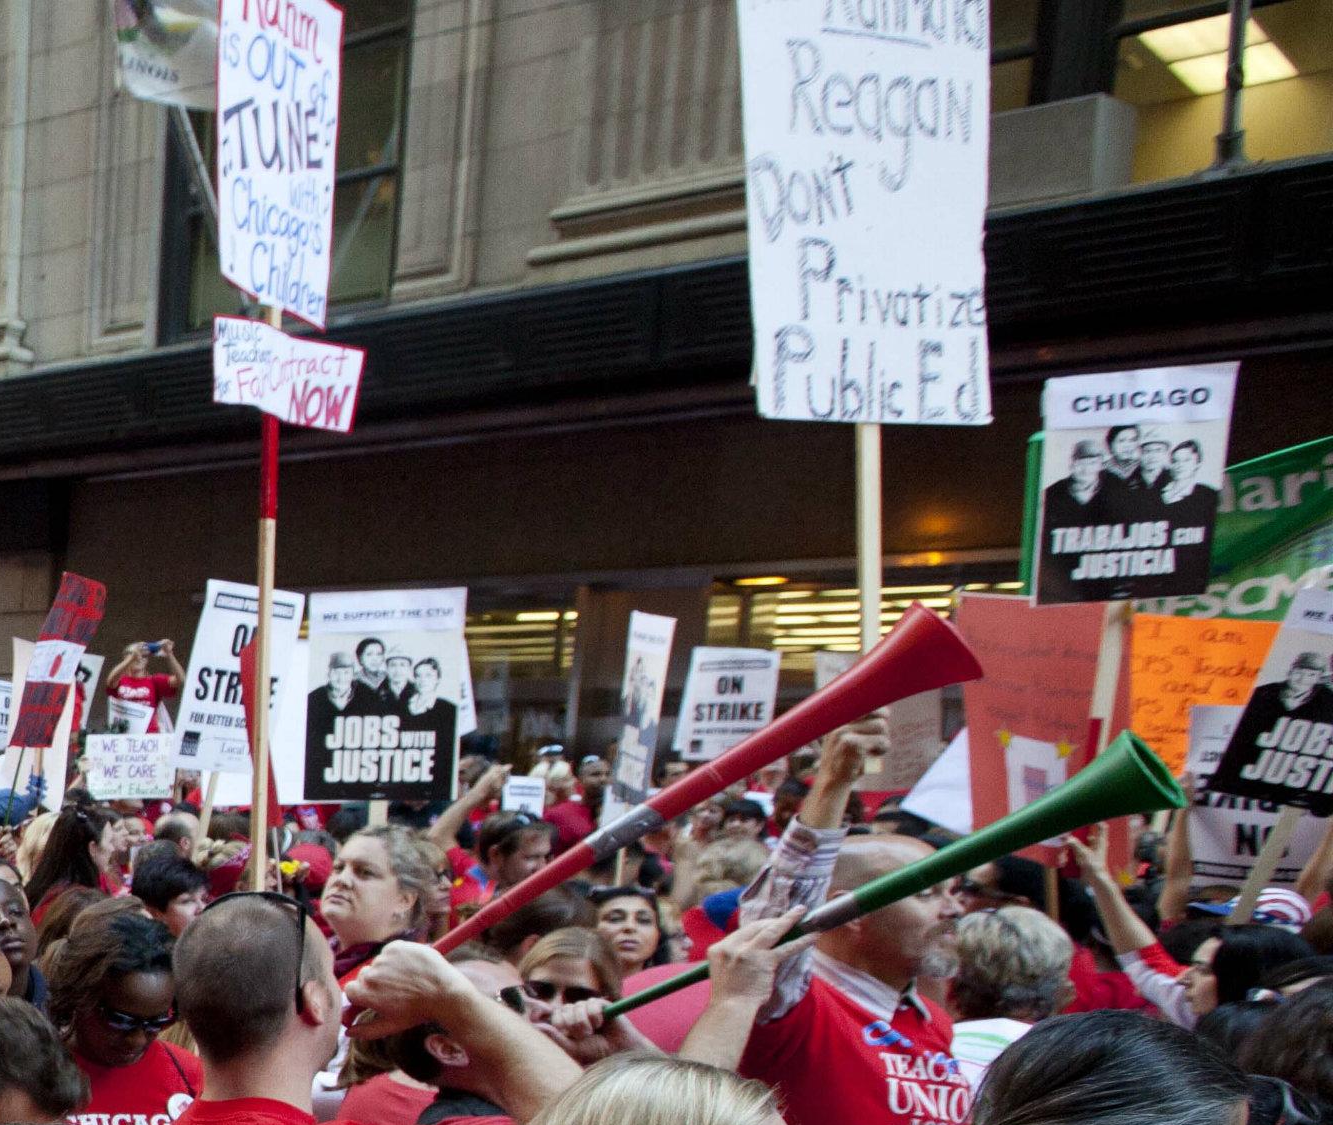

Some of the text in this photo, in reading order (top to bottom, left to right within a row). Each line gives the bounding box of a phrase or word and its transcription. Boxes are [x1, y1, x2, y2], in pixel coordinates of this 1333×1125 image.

[248, 34, 306, 90] OUT
[224, 98, 323, 173] TUNE
[797, 237, 986, 329] Privatize
[773, 325, 980, 421] Public Ed
[288, 380, 351, 427] NOW
[1072, 387, 1212, 414] CHICAGO
[1050, 519, 1169, 554] TRABAJOS
[1070, 548, 1175, 582] JUSTICIA
[400, 608, 424, 619] THE
[717, 675, 745, 695] ON
[190, 711, 234, 726] FOR BETTER
[694, 700, 766, 722] STRIKE
[102, 737, 160, 754] WE TEACH
[221, 742, 245, 755] Local
[324, 714, 437, 751] JOBS WITH
[1256, 716, 1333, 759] JOB
[102, 764, 158, 779] WE CARE
[323, 749, 436, 784] JUSTICE
